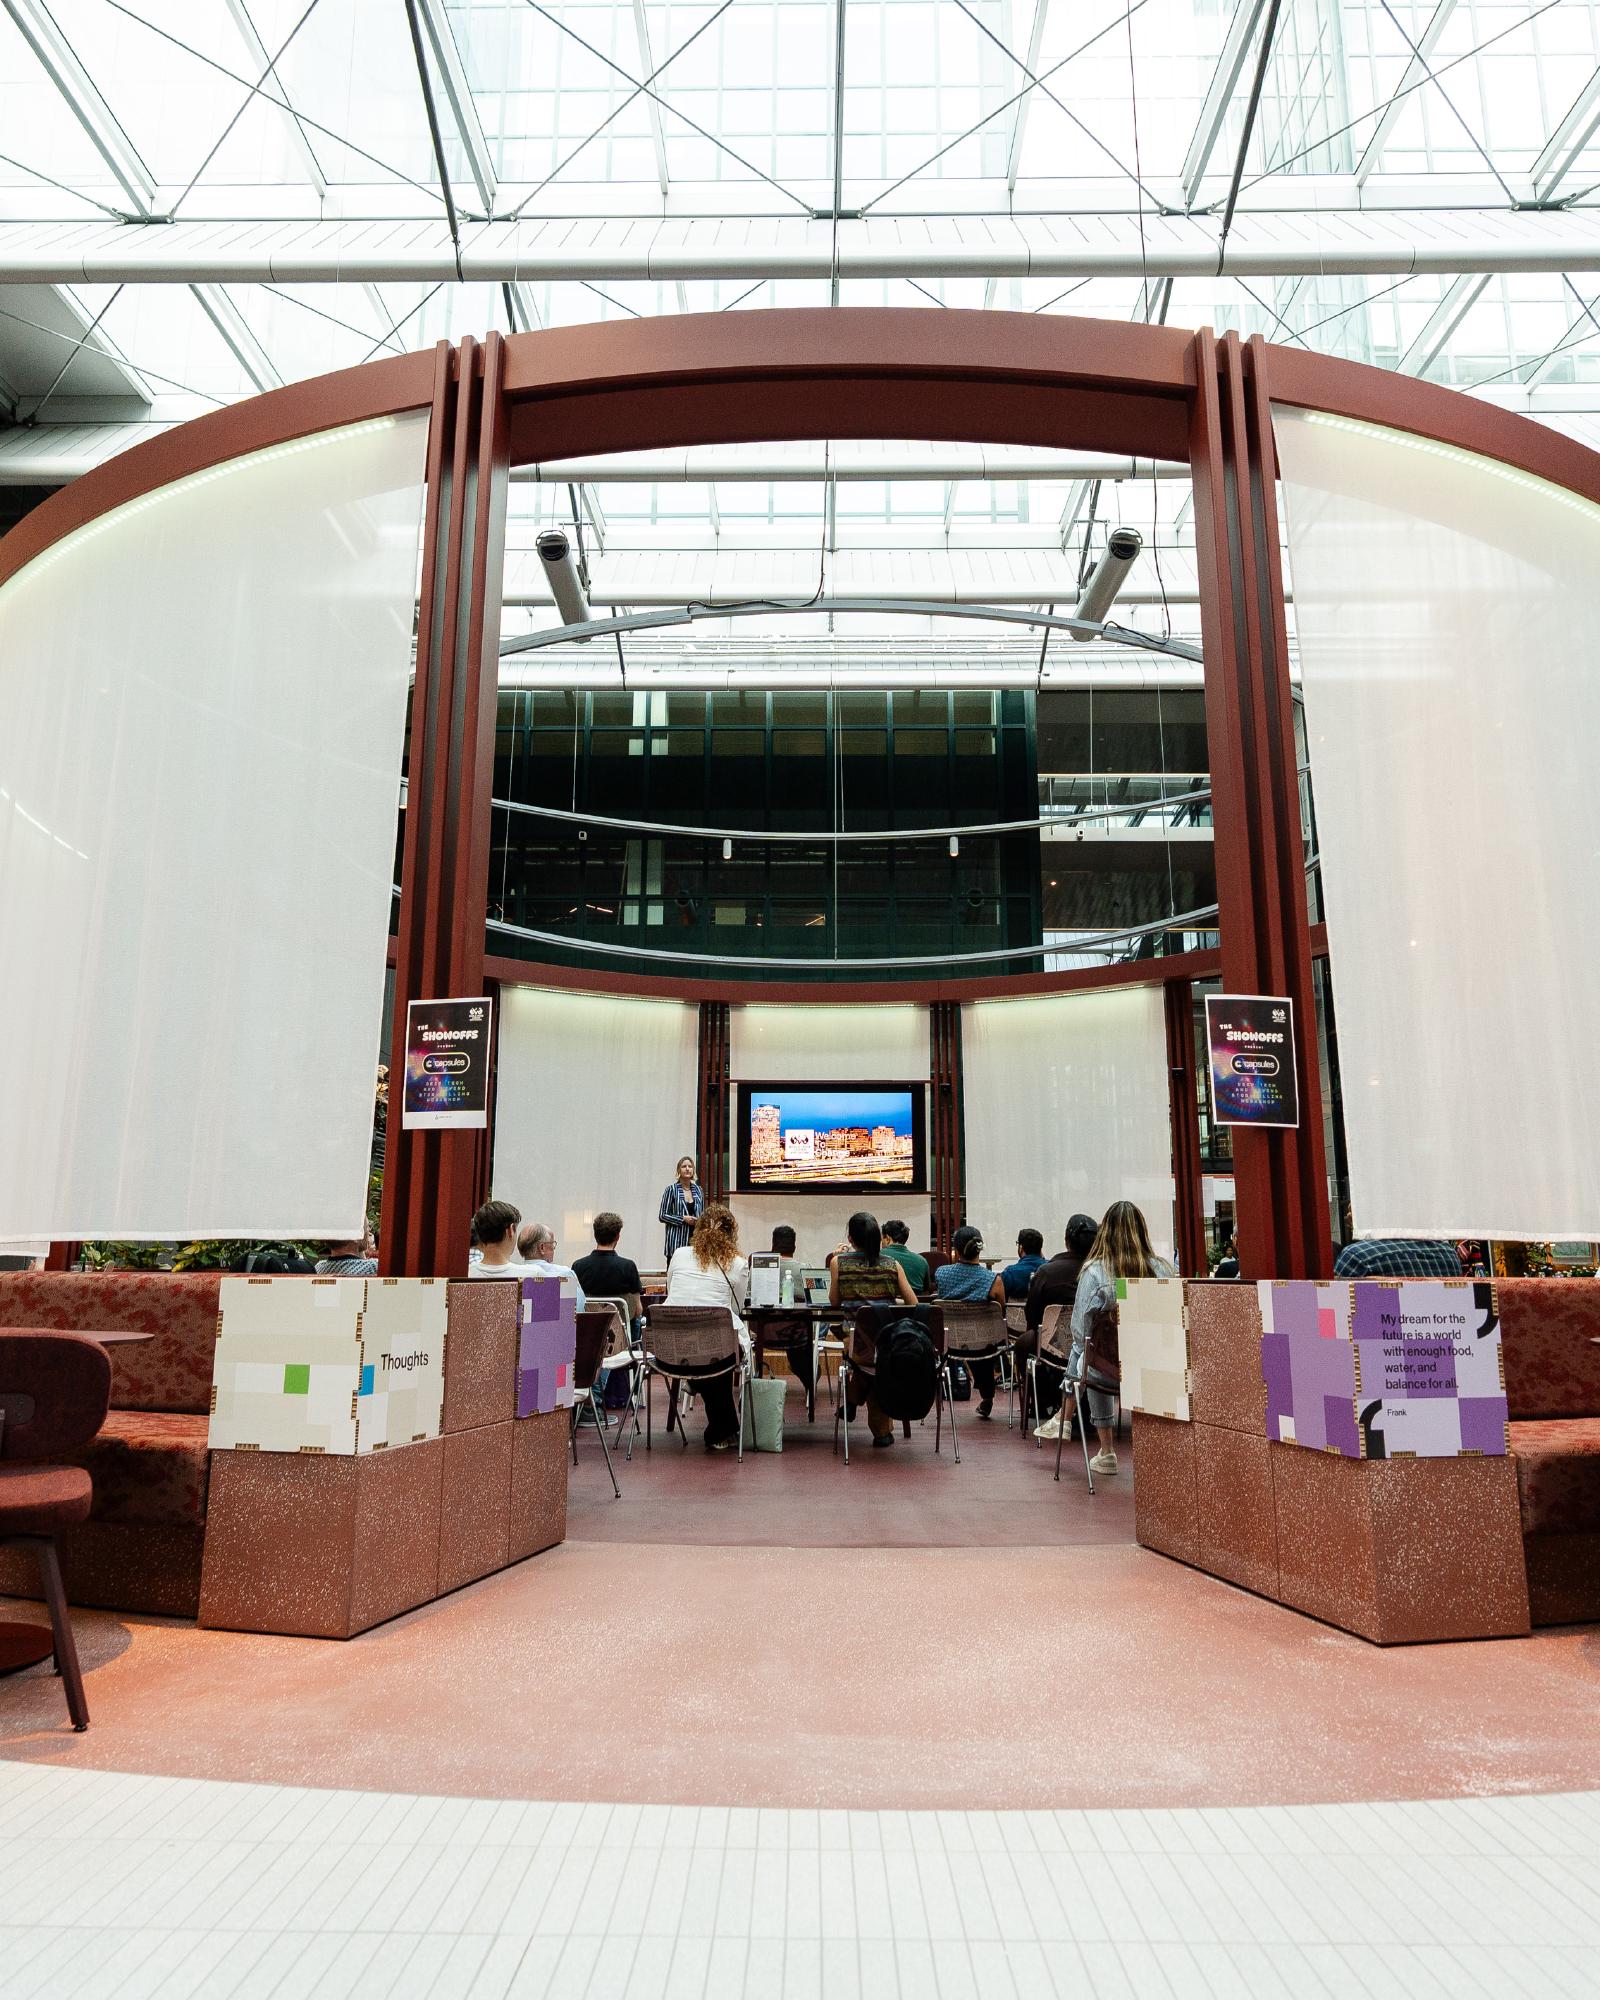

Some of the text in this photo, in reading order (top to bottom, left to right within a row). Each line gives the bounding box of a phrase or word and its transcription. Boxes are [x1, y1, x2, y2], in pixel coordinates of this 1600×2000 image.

[422, 1030, 479, 1041] SHOWOFFS
[1226, 1031, 1284, 1043] SHOWOFFS
[1244, 1060, 1275, 1069] capsules
[815, 1132, 857, 1140] Welcome
[1381, 1314, 1466, 1326] My dream for the
[1382, 1330, 1461, 1340] future is a world
[1383, 1346, 1474, 1358] with enough food,
[381, 1350, 429, 1371] Thoughts
[1385, 1362, 1437, 1375] water, and
[1386, 1378, 1459, 1389] balance for all.
